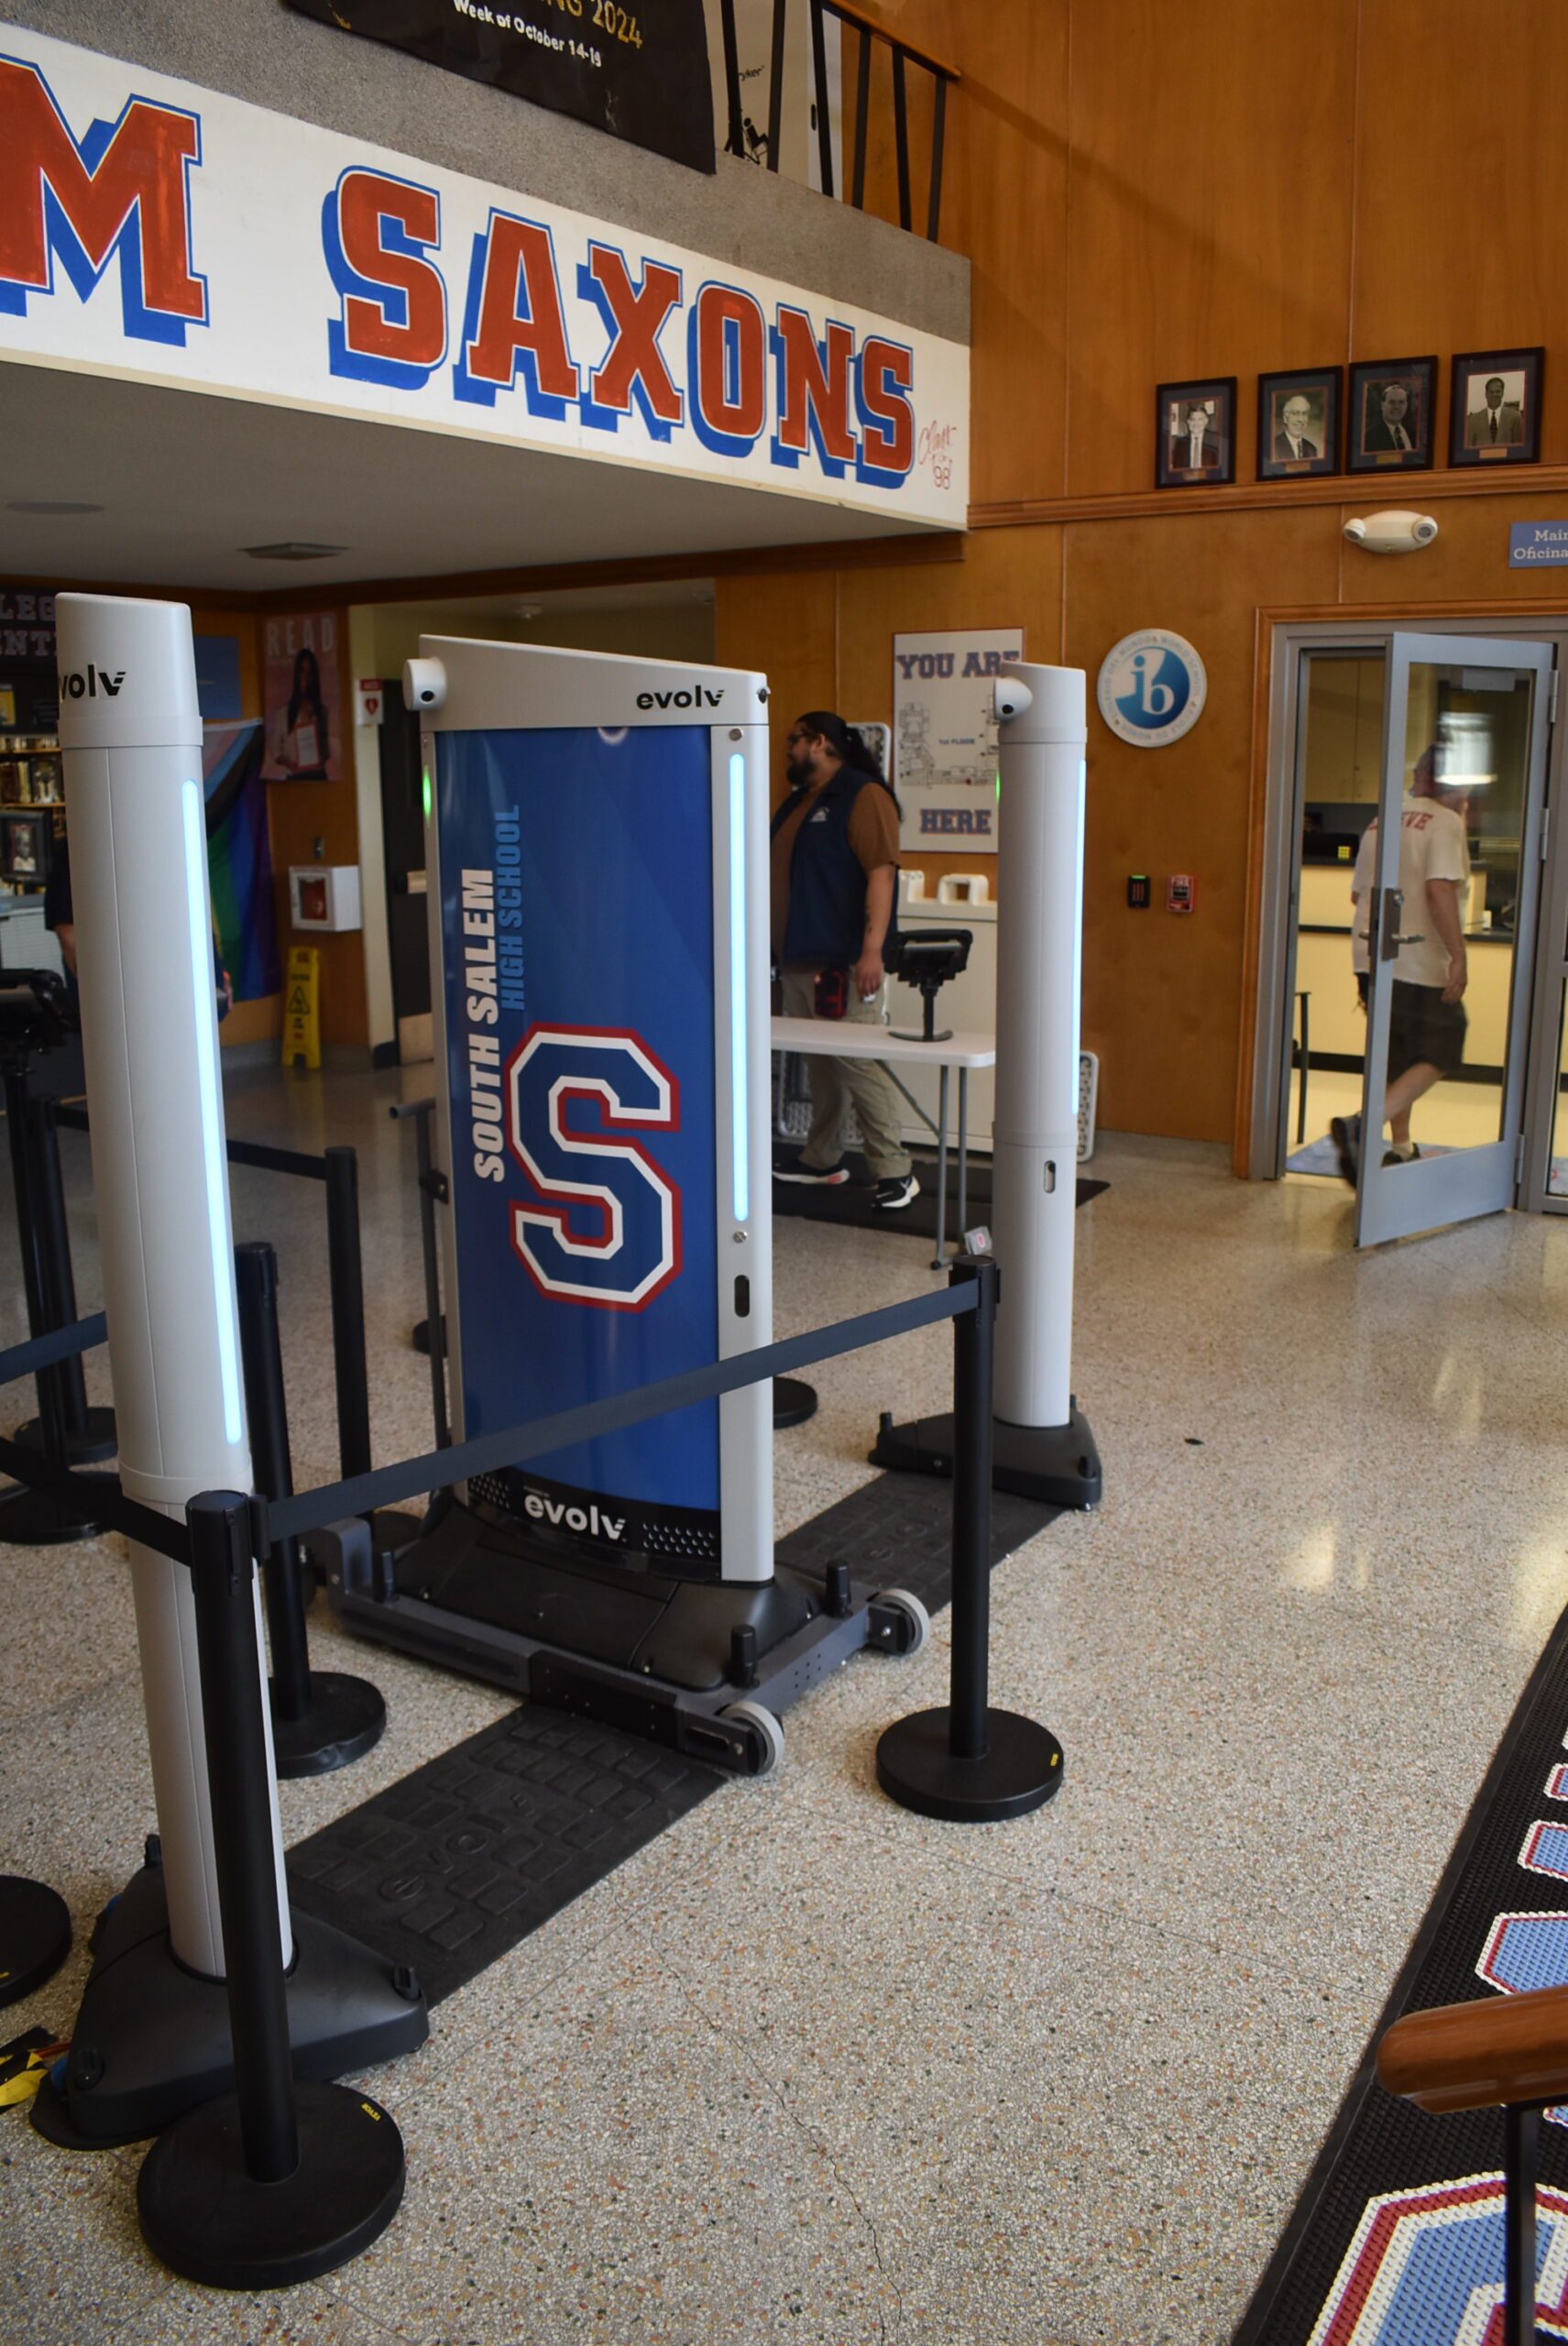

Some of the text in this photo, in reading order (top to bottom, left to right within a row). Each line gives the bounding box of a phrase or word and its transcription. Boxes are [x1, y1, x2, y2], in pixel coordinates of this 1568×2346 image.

[454, 0, 494, 25] Week
[496, 14, 511, 28] of
[513, 16, 565, 51] October
[322, 165, 916, 490] SAXONS
[895, 652, 954, 680] YOU
[1131, 652, 1175, 715] ib
[636, 685, 724, 710] evolv
[920, 808, 992, 835] HERE
[495, 805, 525, 1011] HIGH SCHOOL
[461, 868, 505, 1182] SOUTH SALEM
[503, 1021, 684, 1313] S
[524, 1494, 626, 1540] evolv
